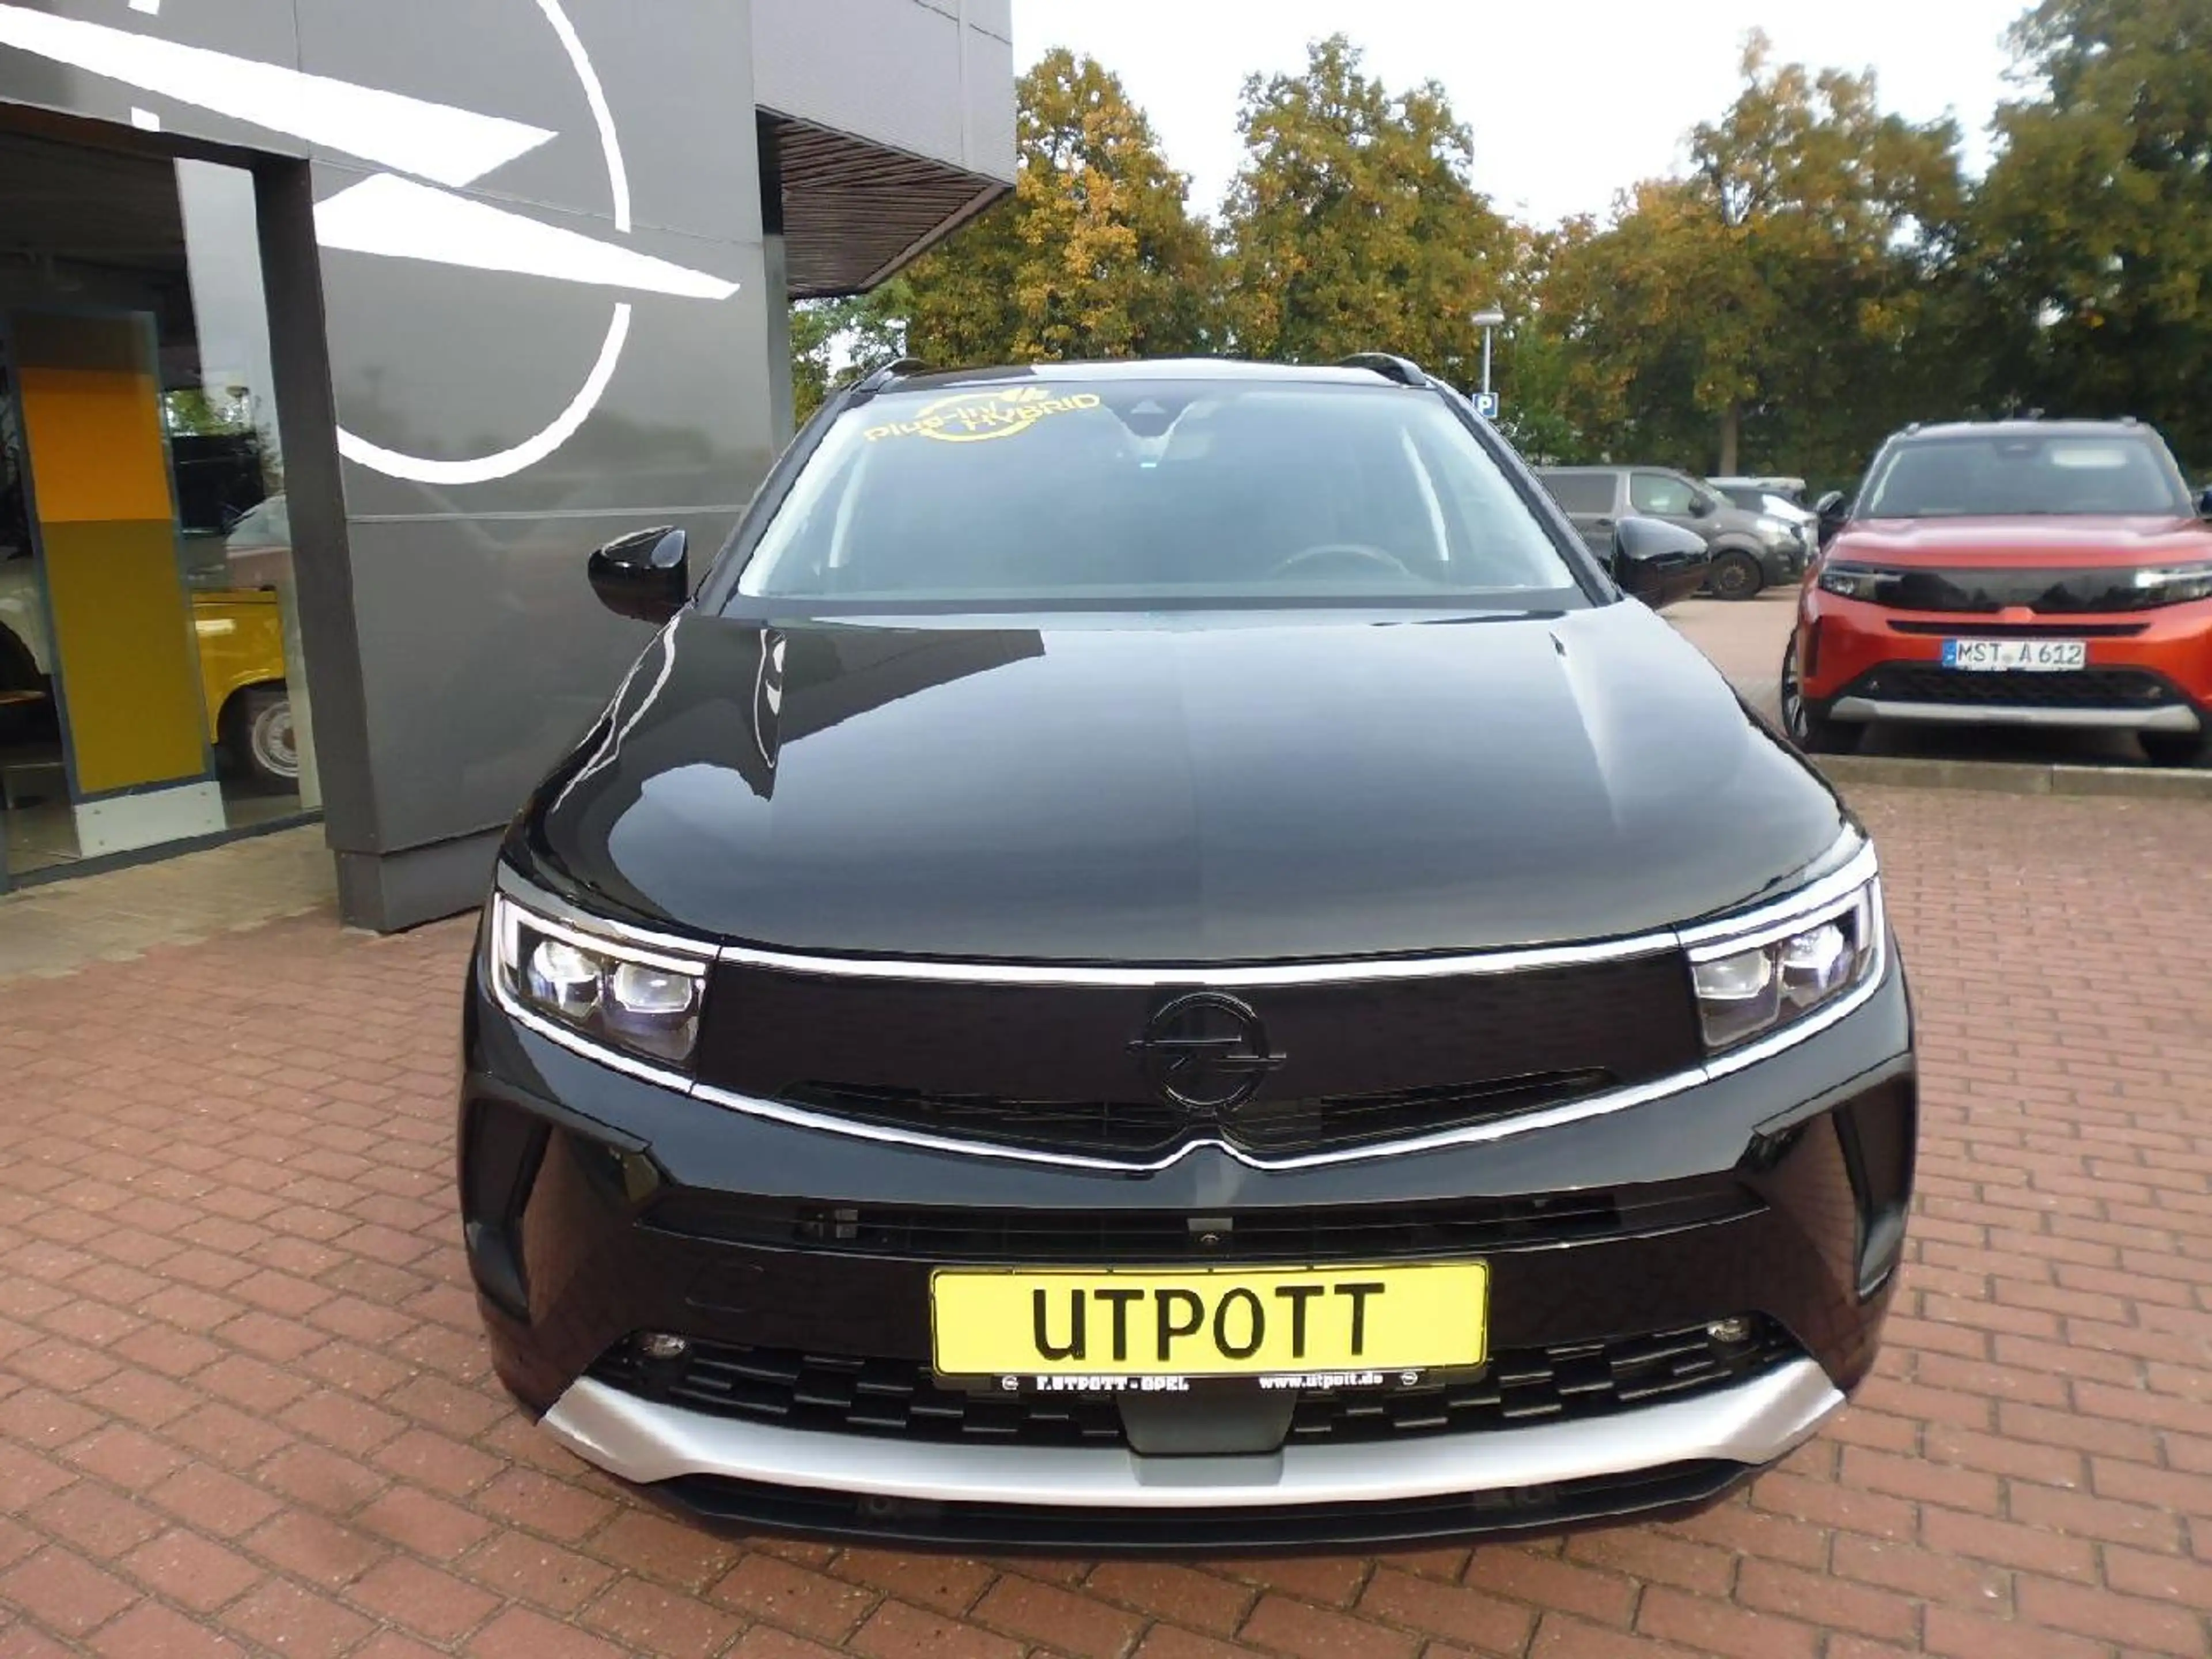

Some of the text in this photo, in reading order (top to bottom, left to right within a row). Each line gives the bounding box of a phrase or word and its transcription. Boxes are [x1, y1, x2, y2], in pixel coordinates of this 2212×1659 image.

[961, 393, 1100, 431] HYBRID
[1478, 396, 1492, 415] P
[1958, 642, 2082, 665] MST A 612
[1033, 1282, 1385, 1361] UTPOTT
[1141, 1376, 1190, 1391] OPEL
[1259, 1372, 1384, 1389] www.utpott.de
